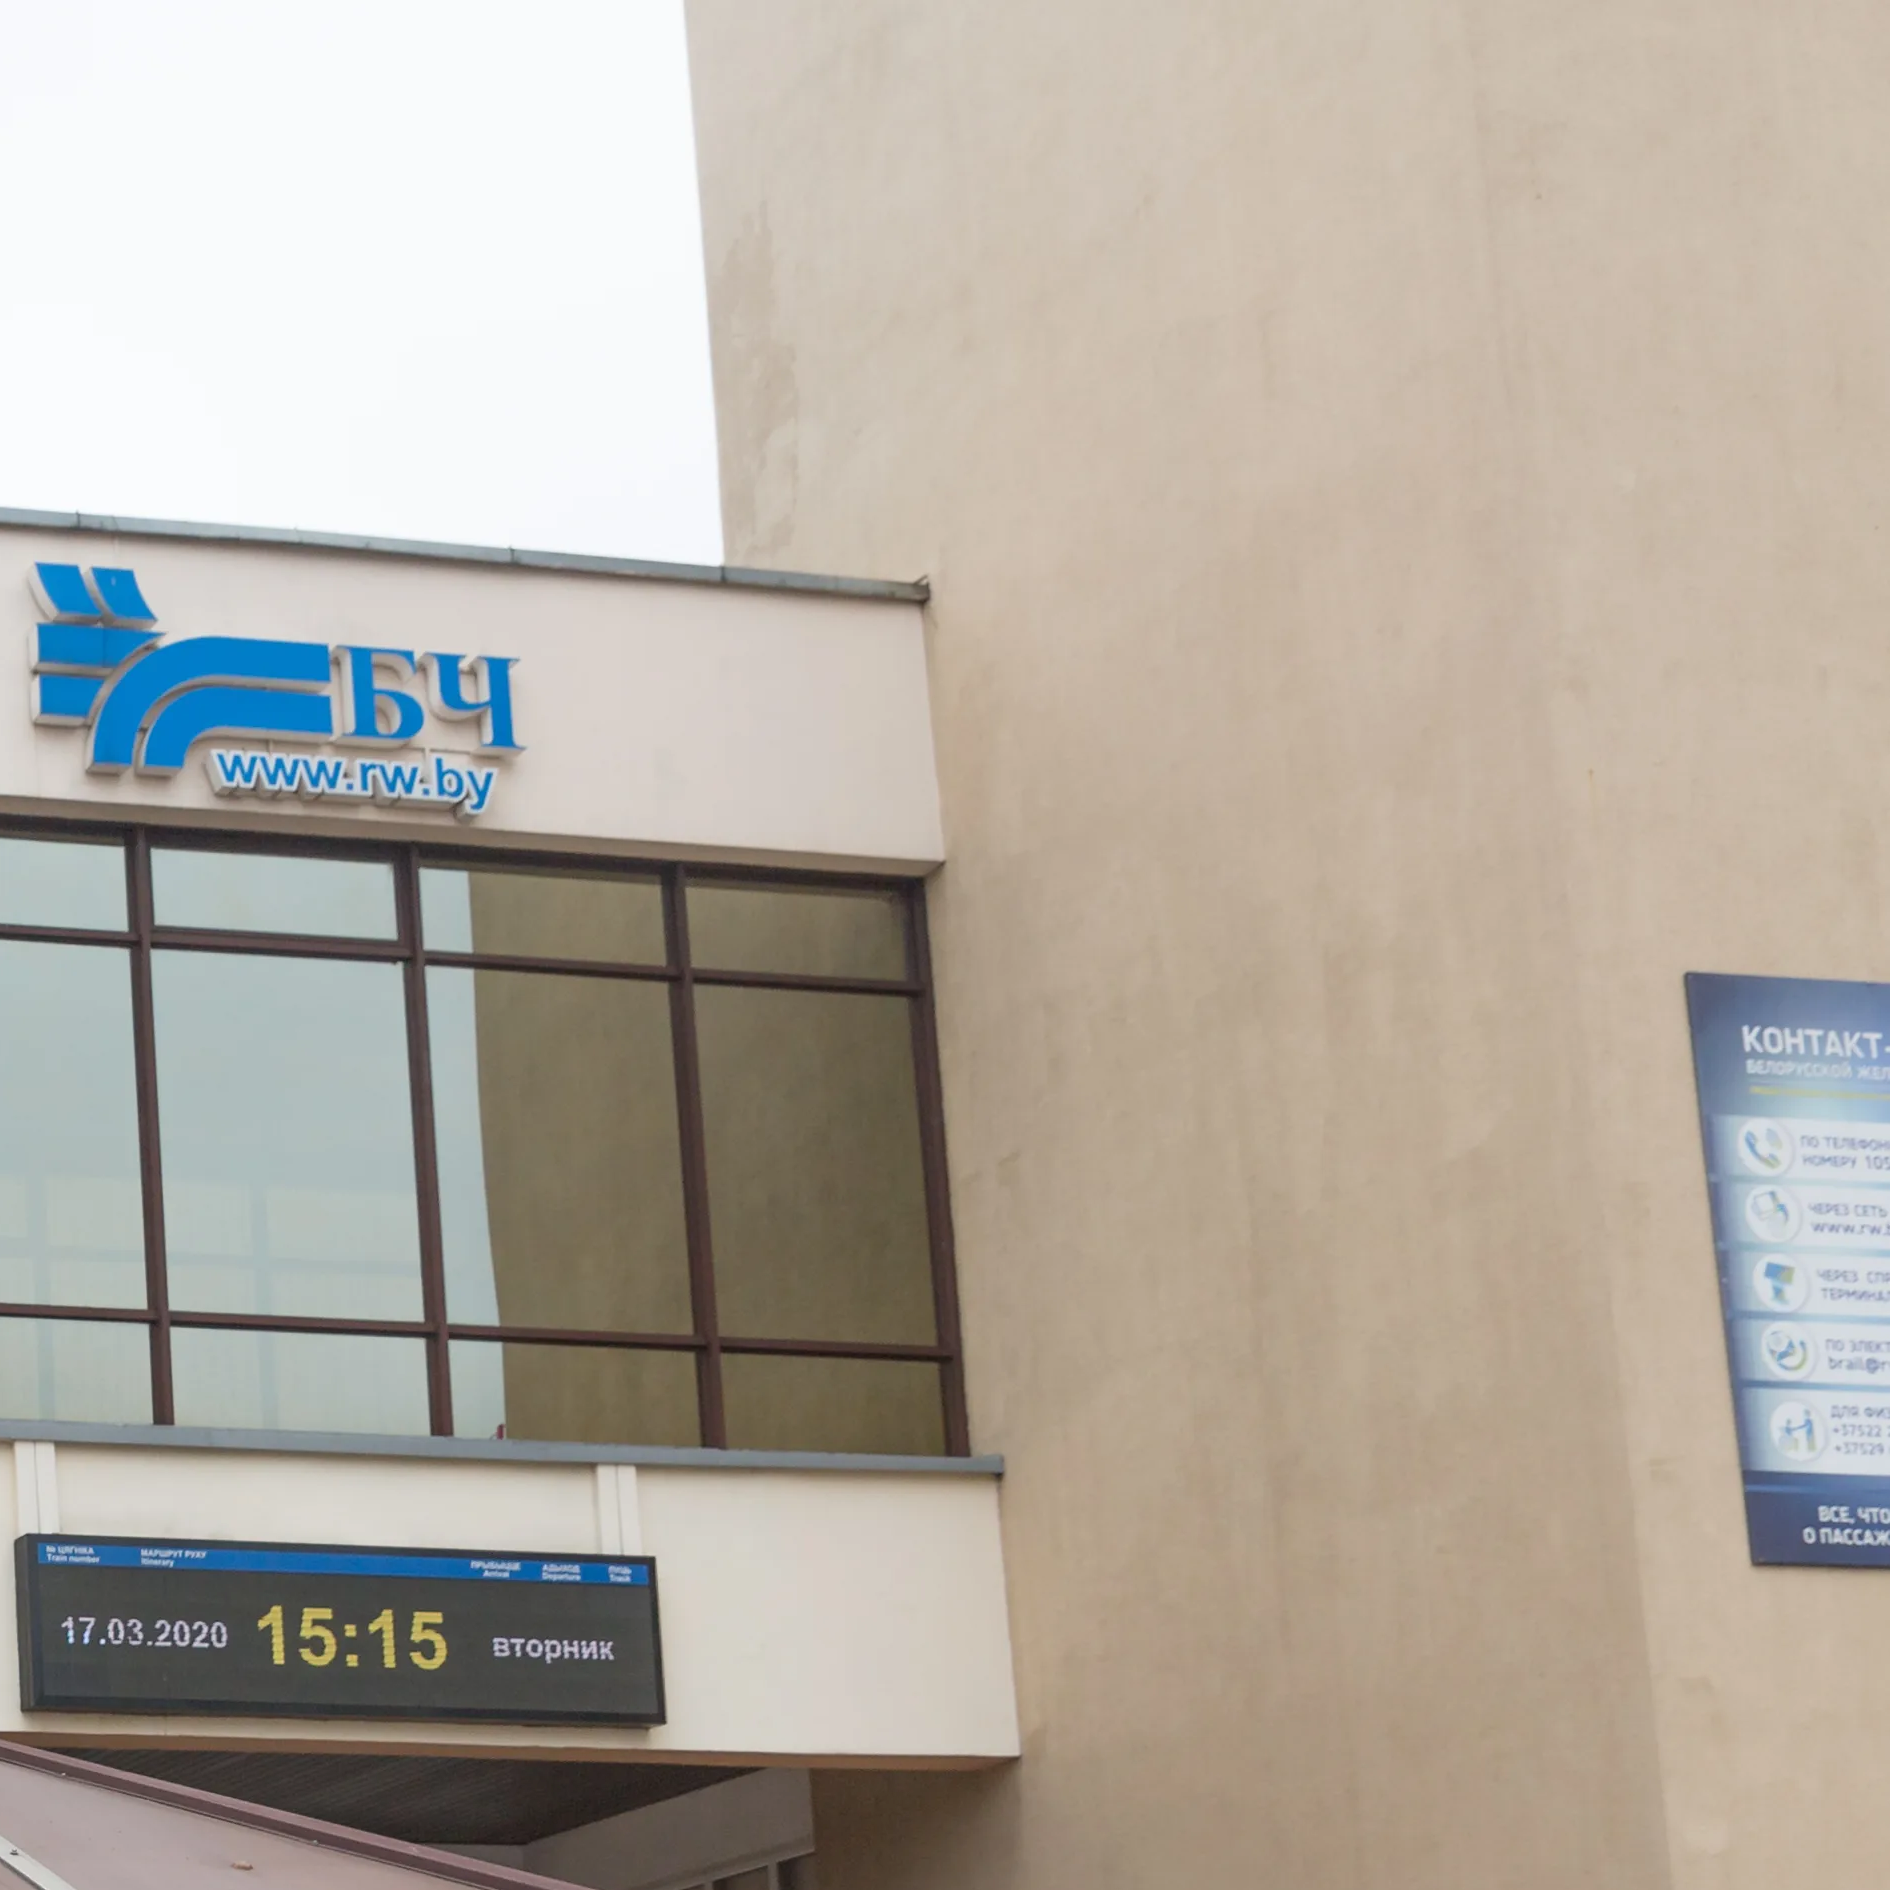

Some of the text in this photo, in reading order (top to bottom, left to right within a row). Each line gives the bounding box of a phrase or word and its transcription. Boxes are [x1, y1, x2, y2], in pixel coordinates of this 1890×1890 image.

[335, 645, 526, 750] БЧ
[214, 750, 497, 812] www.rw.by
[1854, 1204, 1888, 1218] СЕТЬ
[1817, 1505, 1890, 1525] ВСЕ, ЧТО
[1802, 1526, 1816, 1545] О
[47, 1553, 100, 1563] Train number
[61, 1605, 615, 1670] 17.03.2020 15:15 вторник
